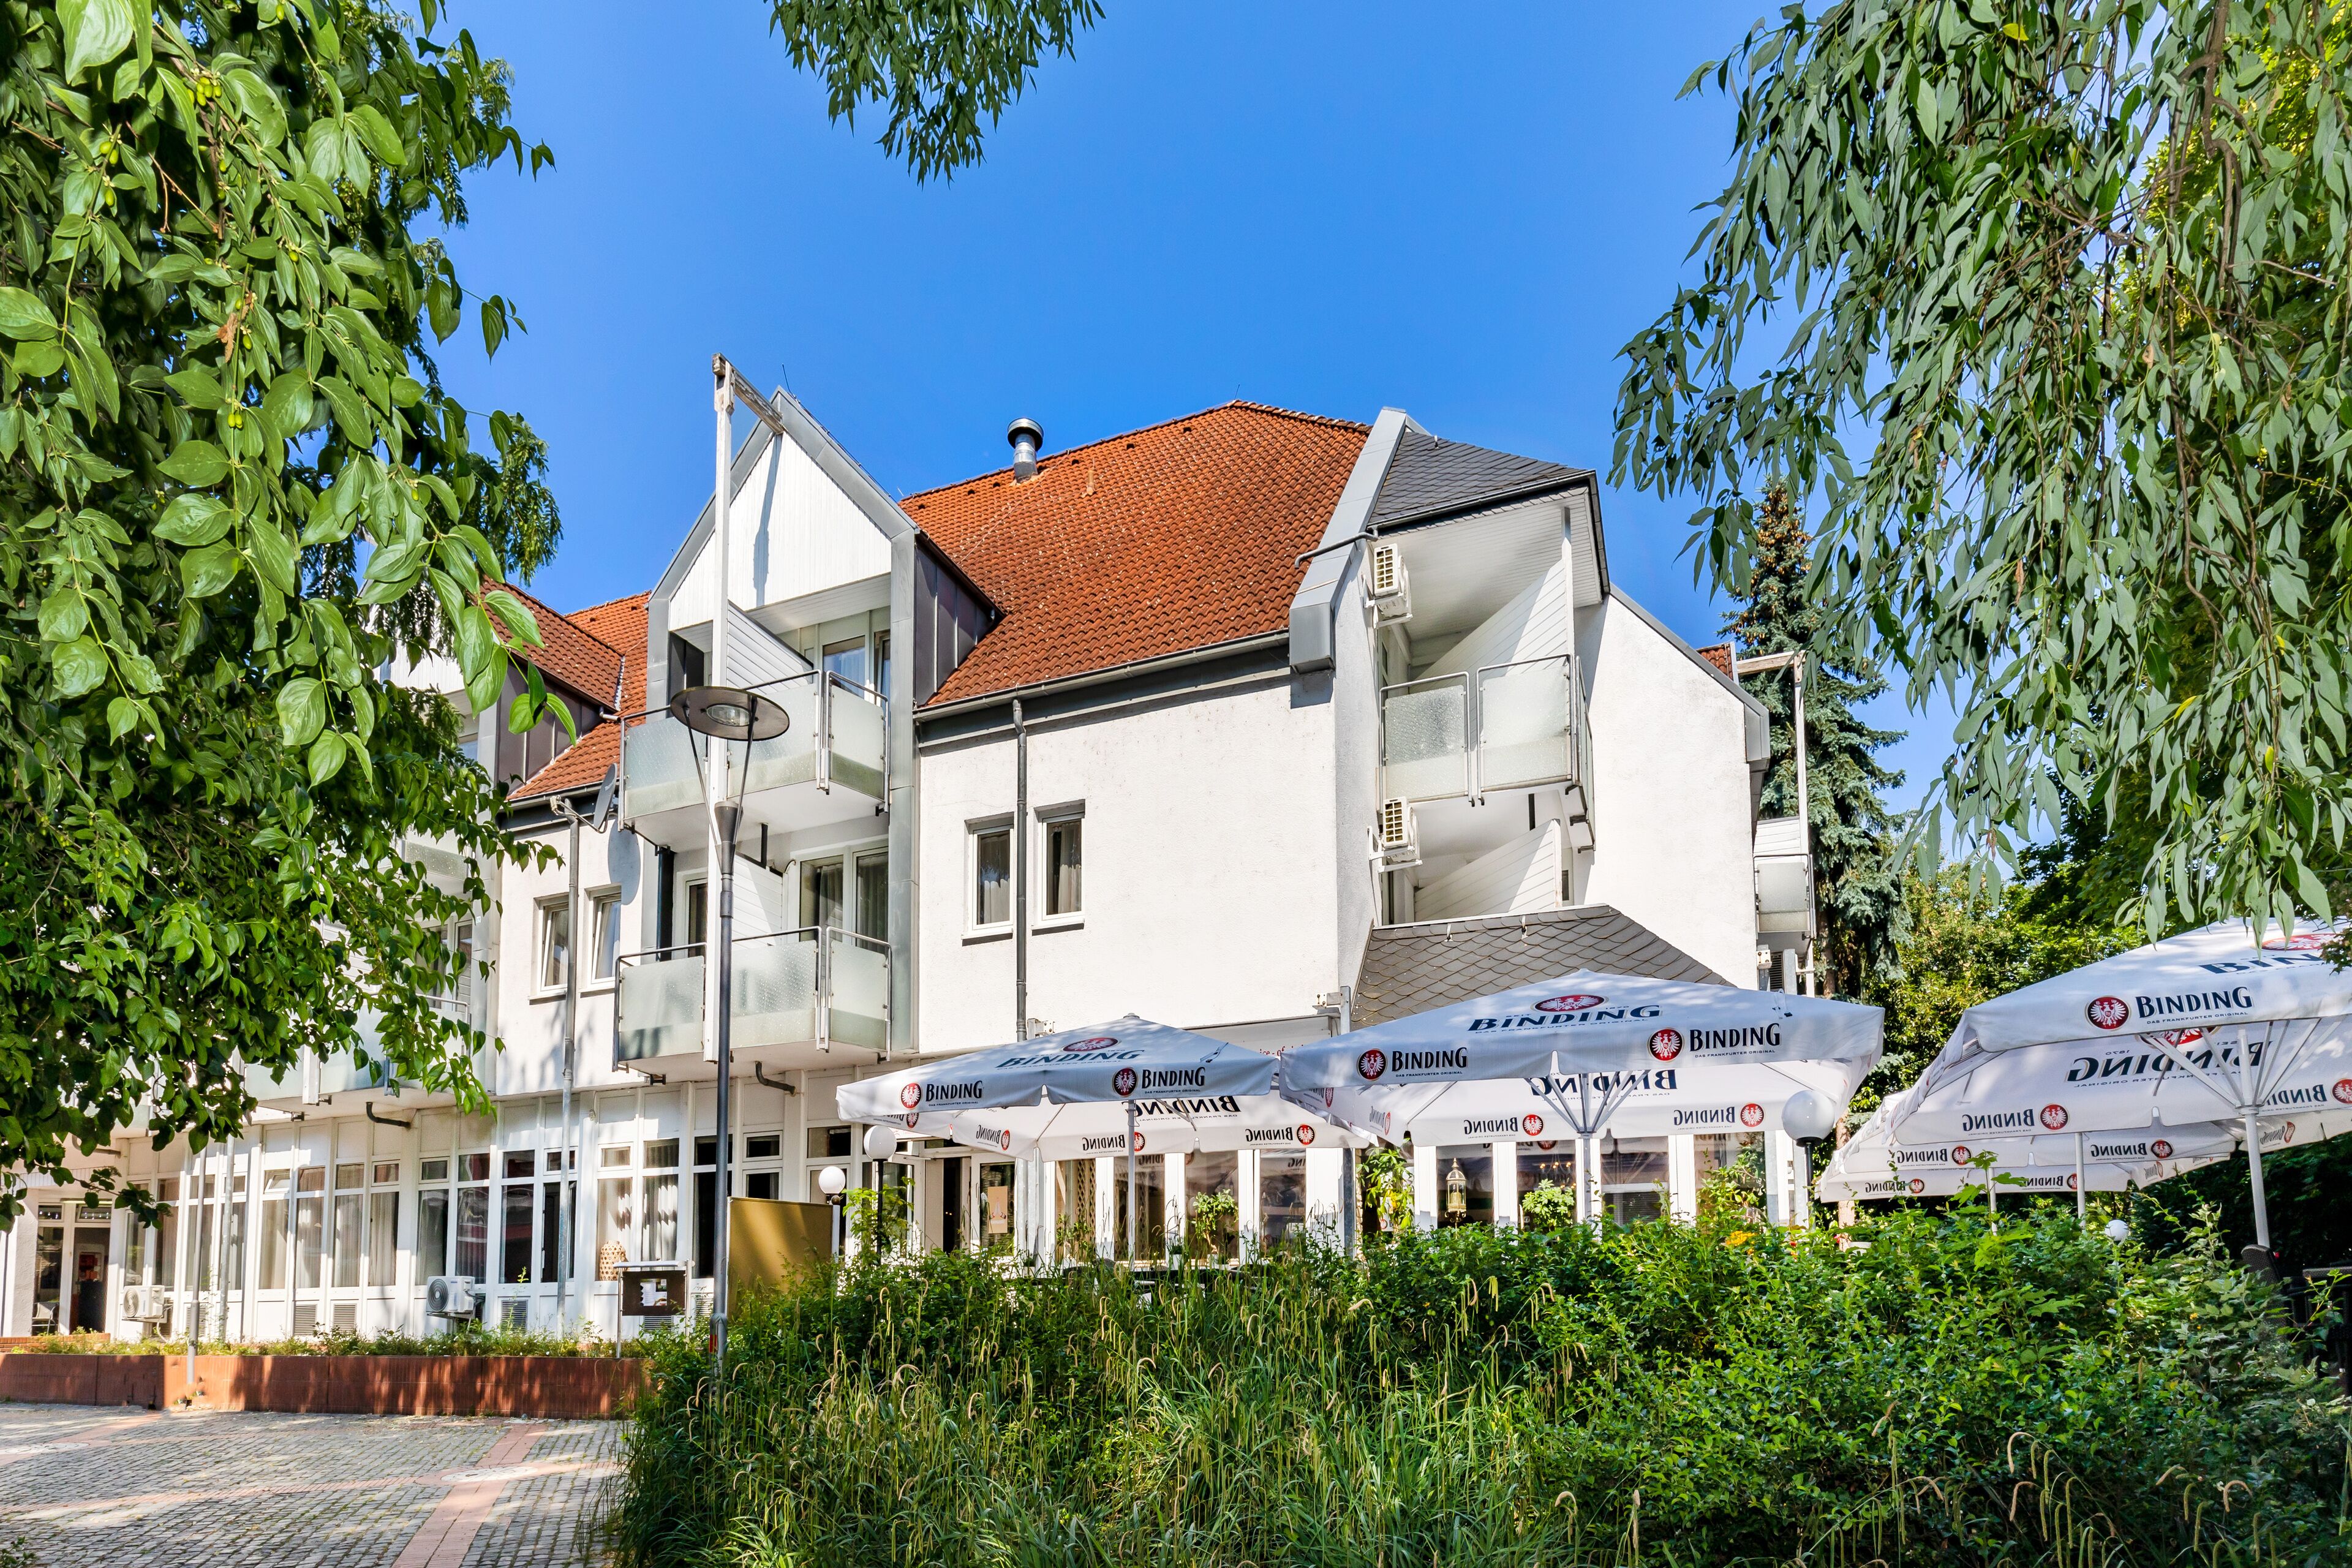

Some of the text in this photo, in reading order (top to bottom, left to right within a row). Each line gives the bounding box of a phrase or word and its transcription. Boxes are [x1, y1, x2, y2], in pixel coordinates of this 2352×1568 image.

[2135, 986, 2253, 1019] BINDING
[1467, 1005, 1660, 1031] BINDING
[2162, 1014, 2213, 1023] FRANKFURTER
[1689, 1022, 1781, 1052] BINDING
[995, 1050, 1145, 1068] BINDING
[1392, 1047, 1468, 1072] BINDING
[1142, 1066, 1205, 1088] BINDING
[925, 1080, 983, 1102] BINDING
